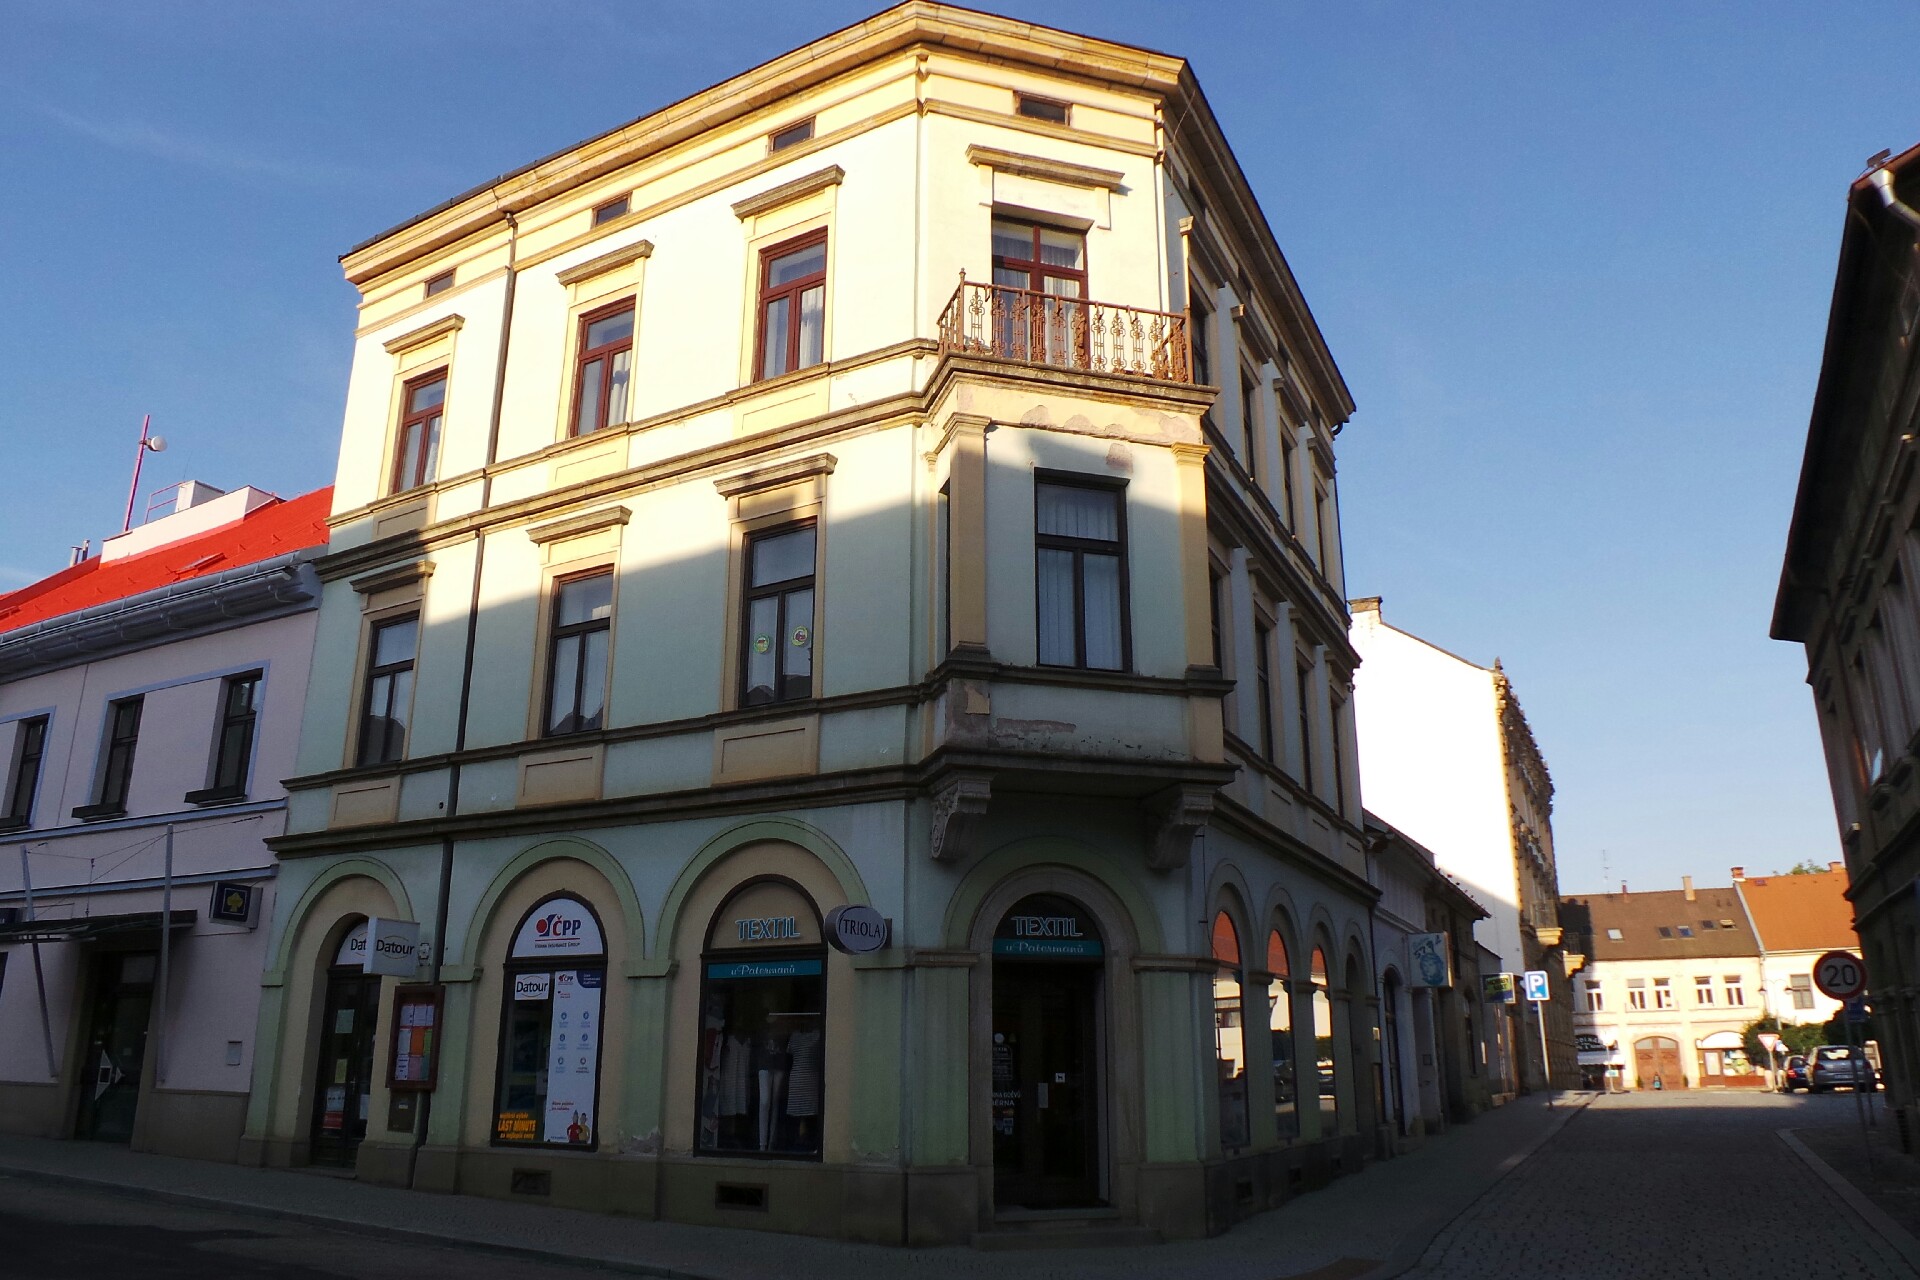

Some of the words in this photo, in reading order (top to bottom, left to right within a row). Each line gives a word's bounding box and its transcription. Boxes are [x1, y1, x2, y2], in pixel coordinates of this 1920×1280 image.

[553, 915, 581, 936] ČPP
[735, 915, 800, 942] TEXTIL
[842, 918, 882, 939] TRIOLA
[1010, 916, 1084, 937] TEXTIL
[350, 938, 367, 951] Dat
[376, 939, 415, 955] Datour
[1530, 975, 1543, 992] P
[1825, 964, 1857, 987] 20
[516, 981, 548, 993] Datour
[498, 1119, 514, 1132] LAST
[513, 1119, 537, 1132] MINUTE
